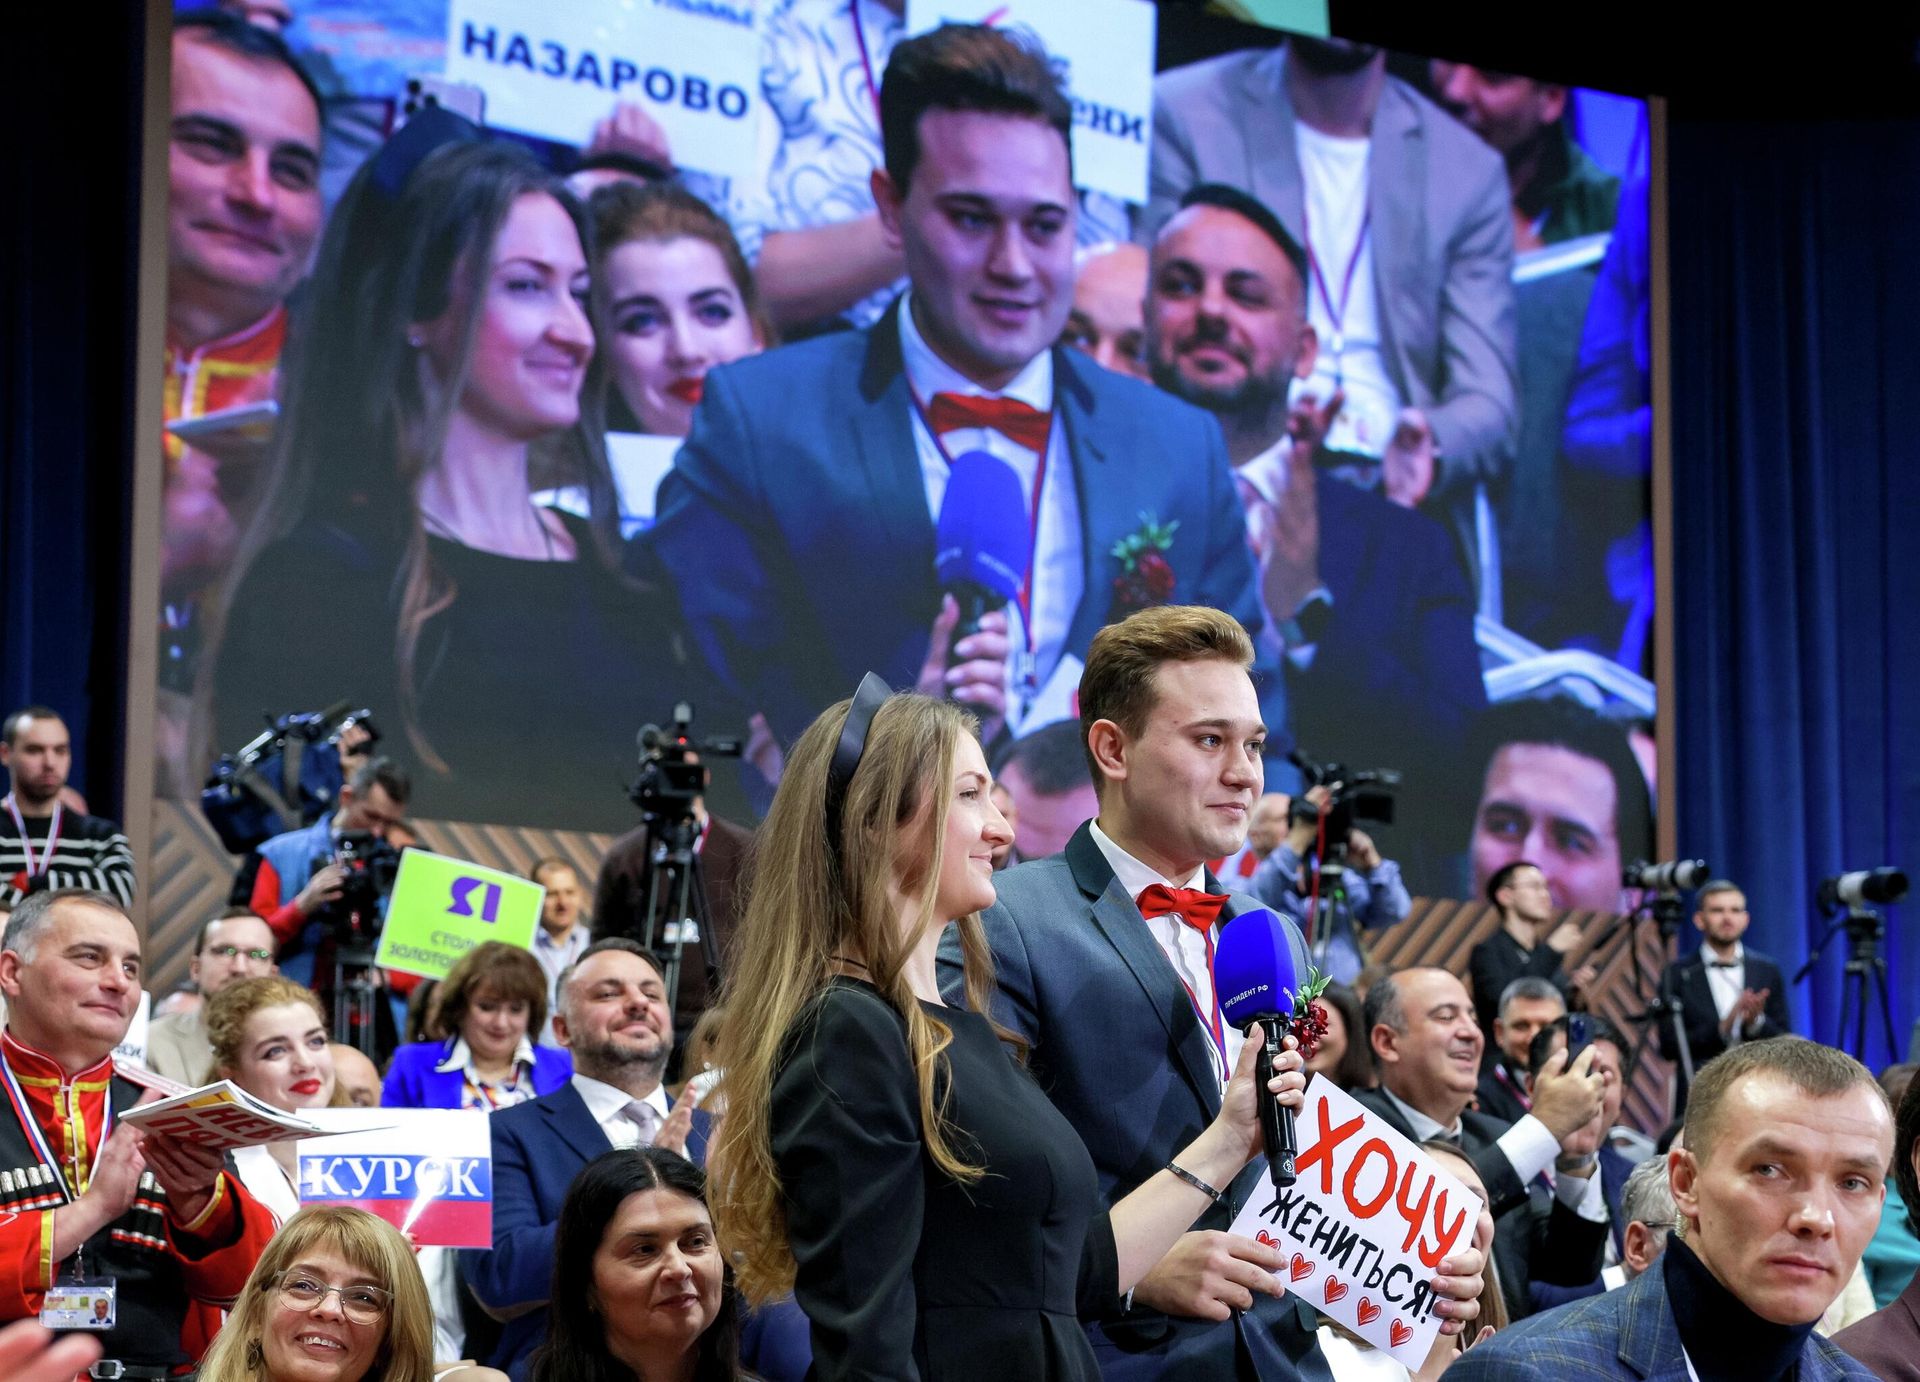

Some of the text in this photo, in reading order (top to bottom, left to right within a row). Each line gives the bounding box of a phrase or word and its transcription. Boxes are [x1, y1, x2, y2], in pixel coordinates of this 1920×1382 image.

[462, 22, 749, 120] НАЗАРОВО
[431, 930, 476, 951] СТОЛ
[1225, 984, 1269, 1009] ПРЕЗИДЕНТ РФ
[306, 1157, 484, 1198] КУРСК
[1295, 1096, 1467, 1268] ХОЧУ
[1259, 1186, 1439, 1324] ЖЕНИТЬСЯ!
